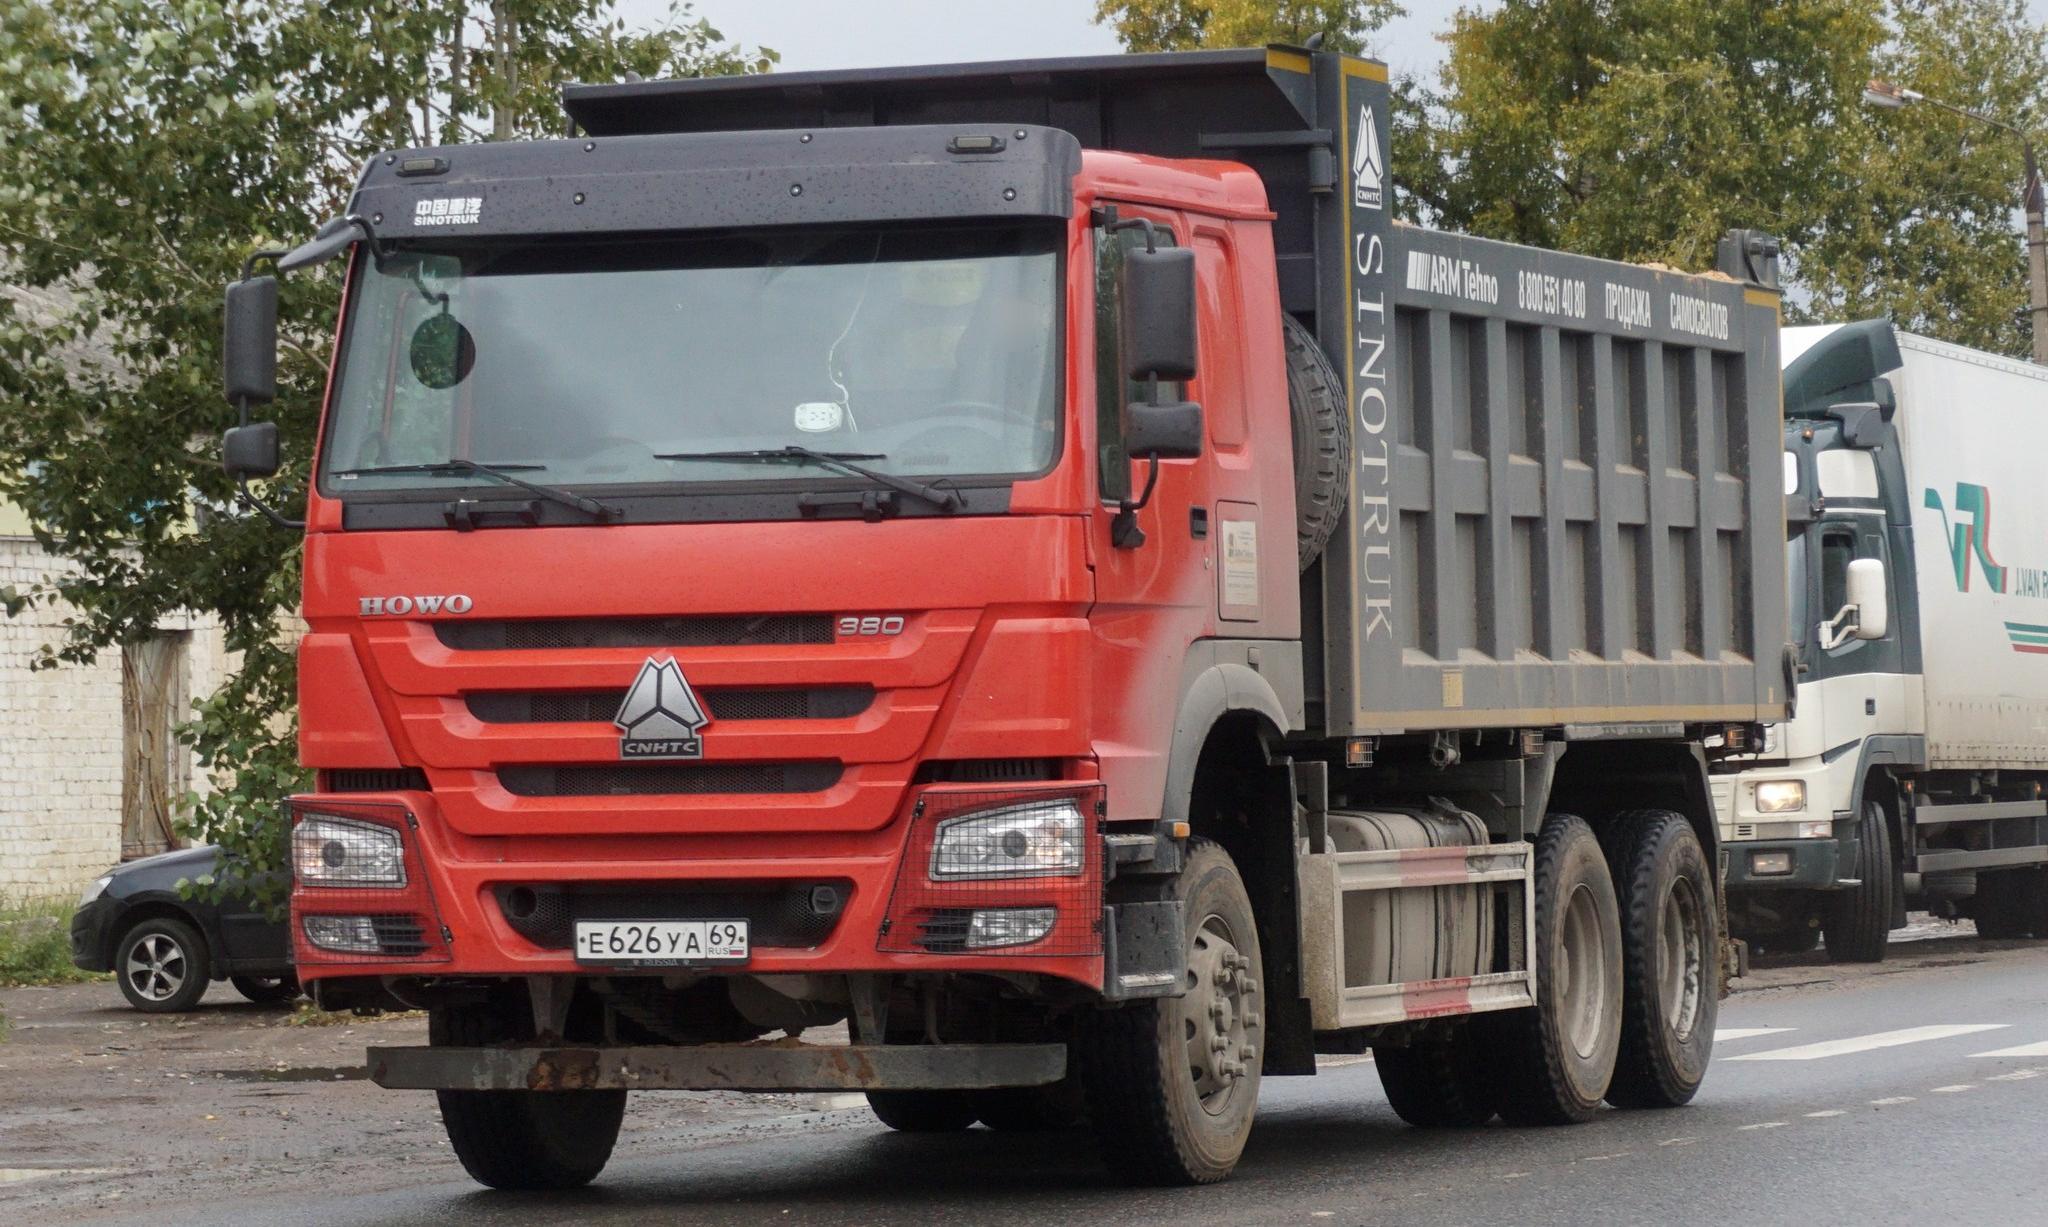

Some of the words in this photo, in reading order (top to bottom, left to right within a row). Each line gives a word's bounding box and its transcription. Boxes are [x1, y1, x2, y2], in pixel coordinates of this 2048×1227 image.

[414, 214, 480, 226] SINOTRUK
[1430, 254, 1460, 298] ARM
[1461, 260, 1499, 305] Tehno
[1605, 282, 1652, 331] ПРОДАЖА
[1670, 291, 1729, 341] САМОСВАЛОВ
[1356, 232, 1393, 640] SINOTRUK
[359, 594, 473, 615] HOWO
[838, 616, 905, 635] 380
[624, 741, 697, 753] CNHTC
[709, 924, 737, 946] 69
[708, 947, 729, 955] RUS
